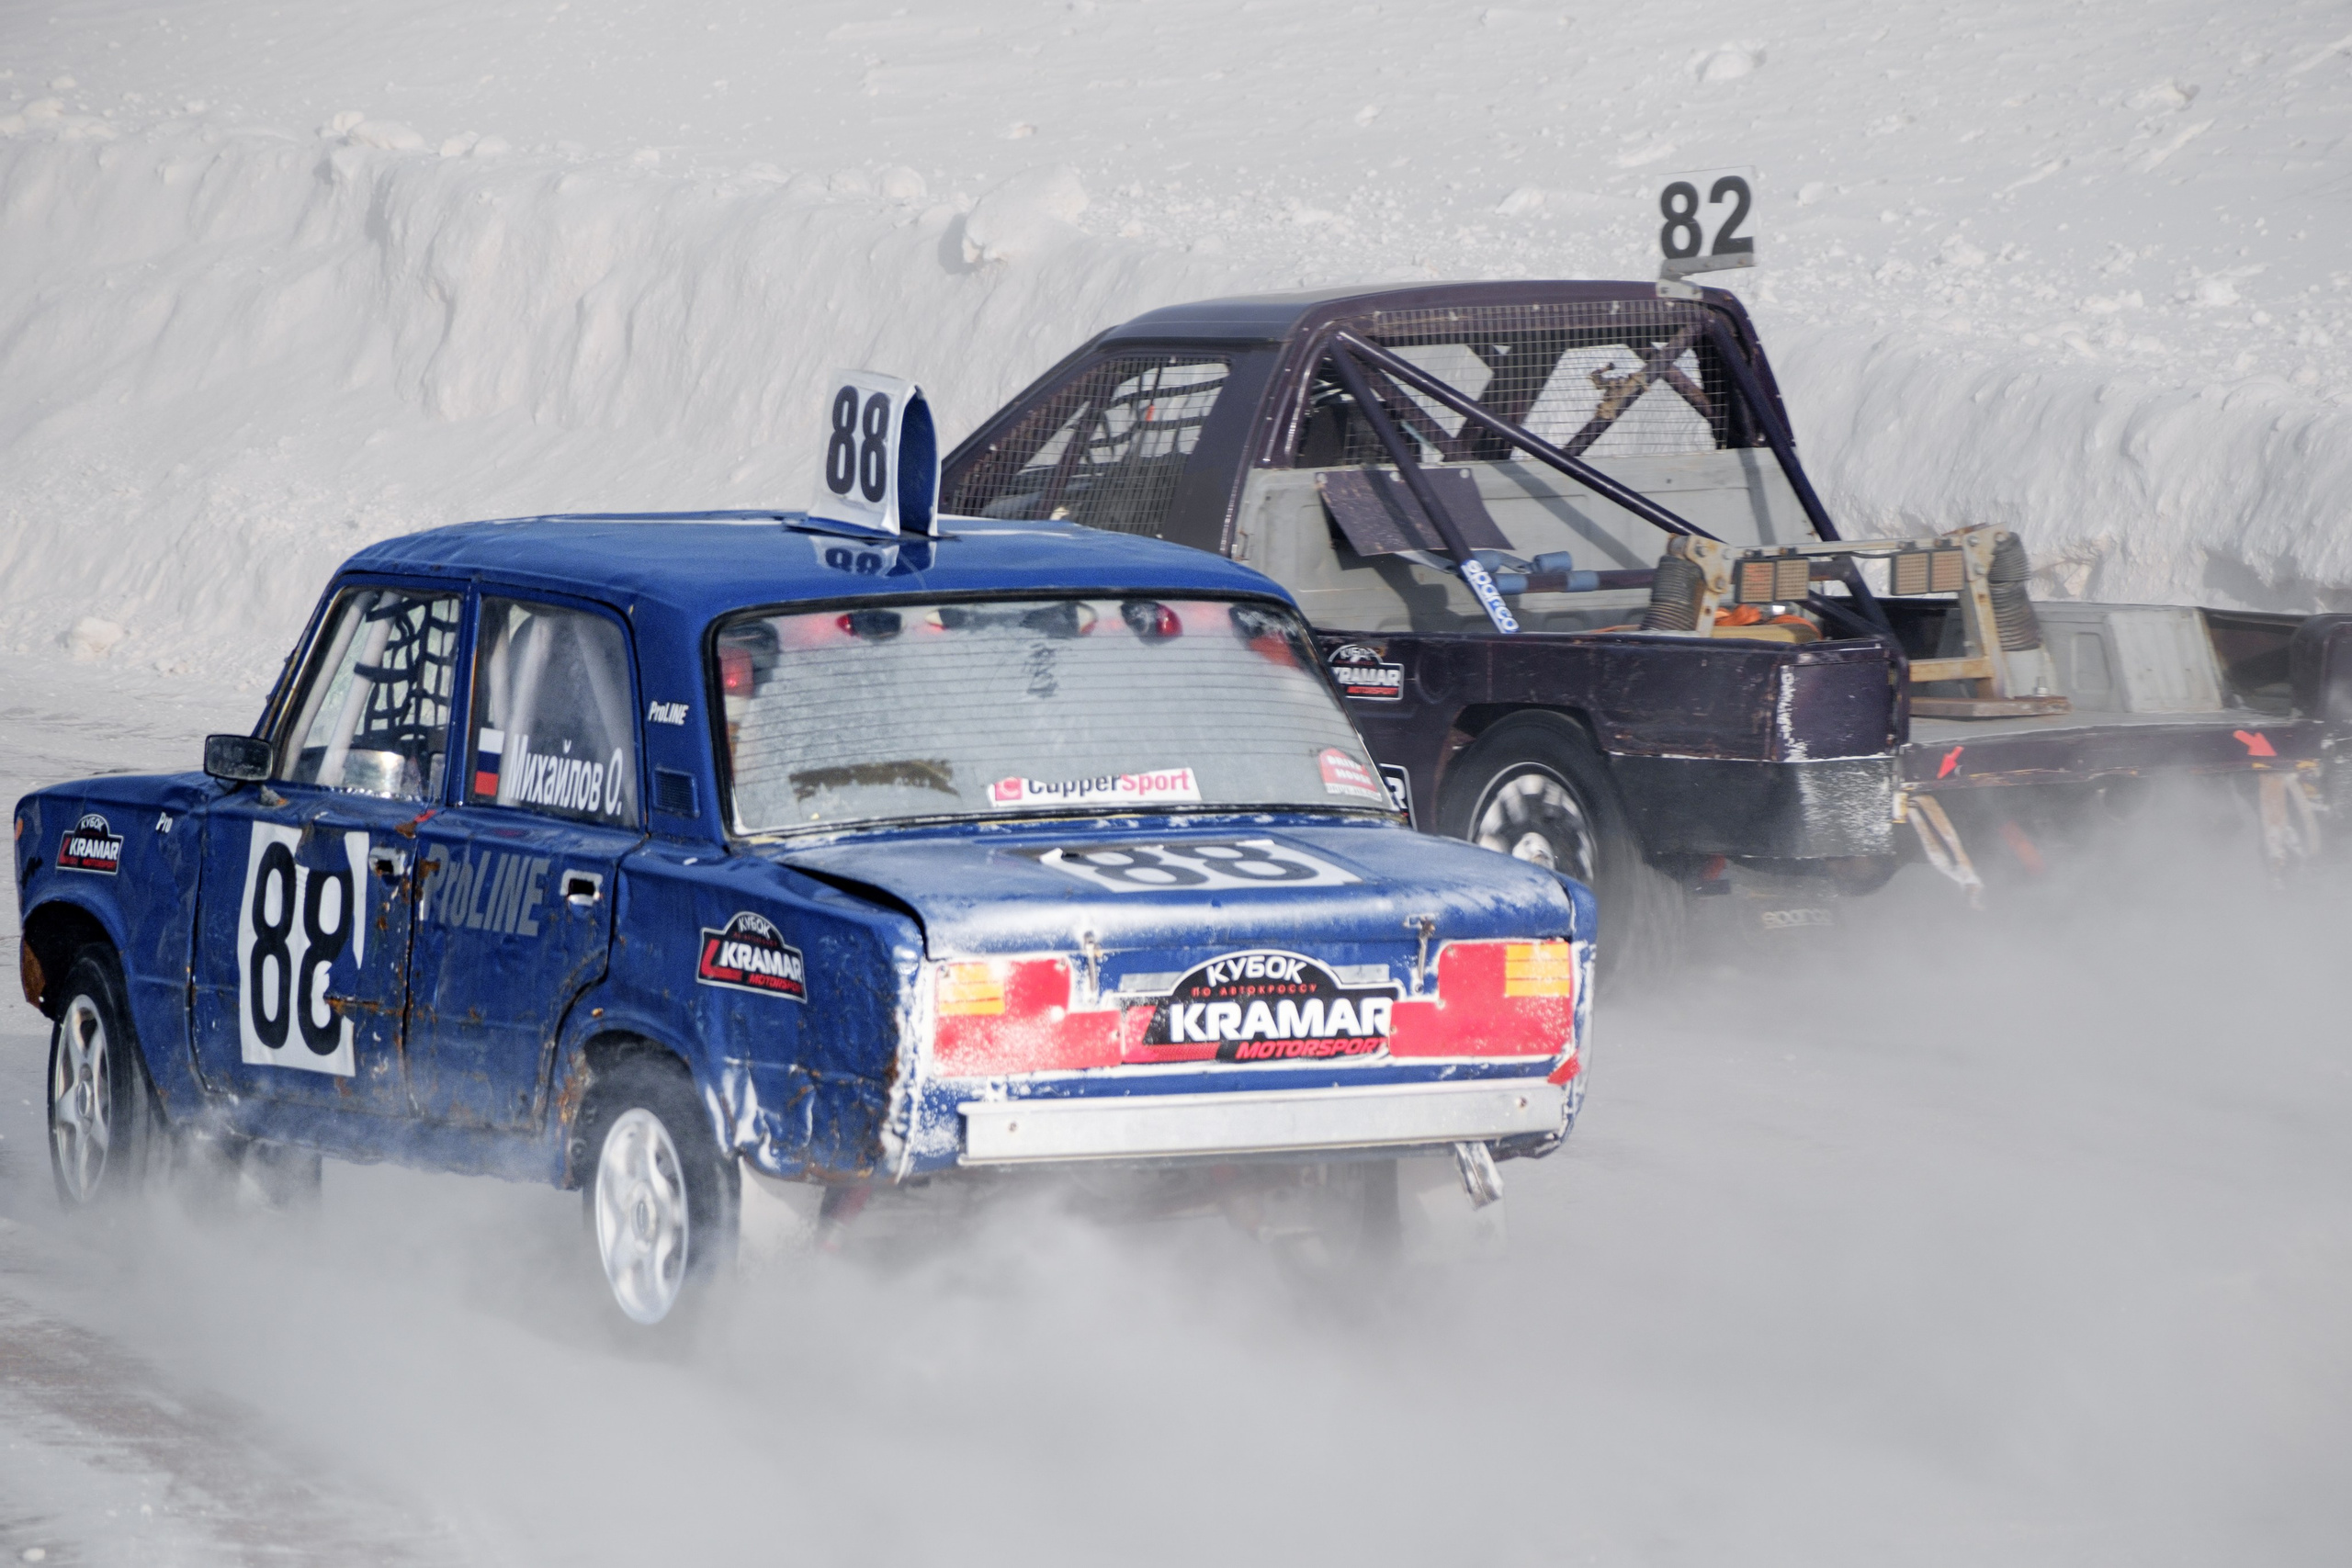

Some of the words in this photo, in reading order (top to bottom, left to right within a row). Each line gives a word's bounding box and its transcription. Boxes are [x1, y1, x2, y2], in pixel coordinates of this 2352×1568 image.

[1661, 175, 1753, 259] 82
[826, 385, 890, 502] 88
[1466, 559, 1520, 631] sparco
[648, 700, 688, 726] ProLINE
[507, 734, 604, 812] Михайлов
[155, 811, 174, 834] Pro
[69, 838, 119, 861] KRAMAR
[1061, 843, 1320, 886] 88
[421, 842, 551, 937] ProLINE
[250, 840, 355, 1057] 88
[738, 916, 772, 940] КУБОК
[719, 941, 803, 983] KRAMAR
[1206, 955, 1307, 987] КУБОК
[1191, 987, 1212, 998] ПО
[1219, 983, 1317, 998] АВТОКРОССУ
[1170, 997, 1394, 1043] KRAMAR
